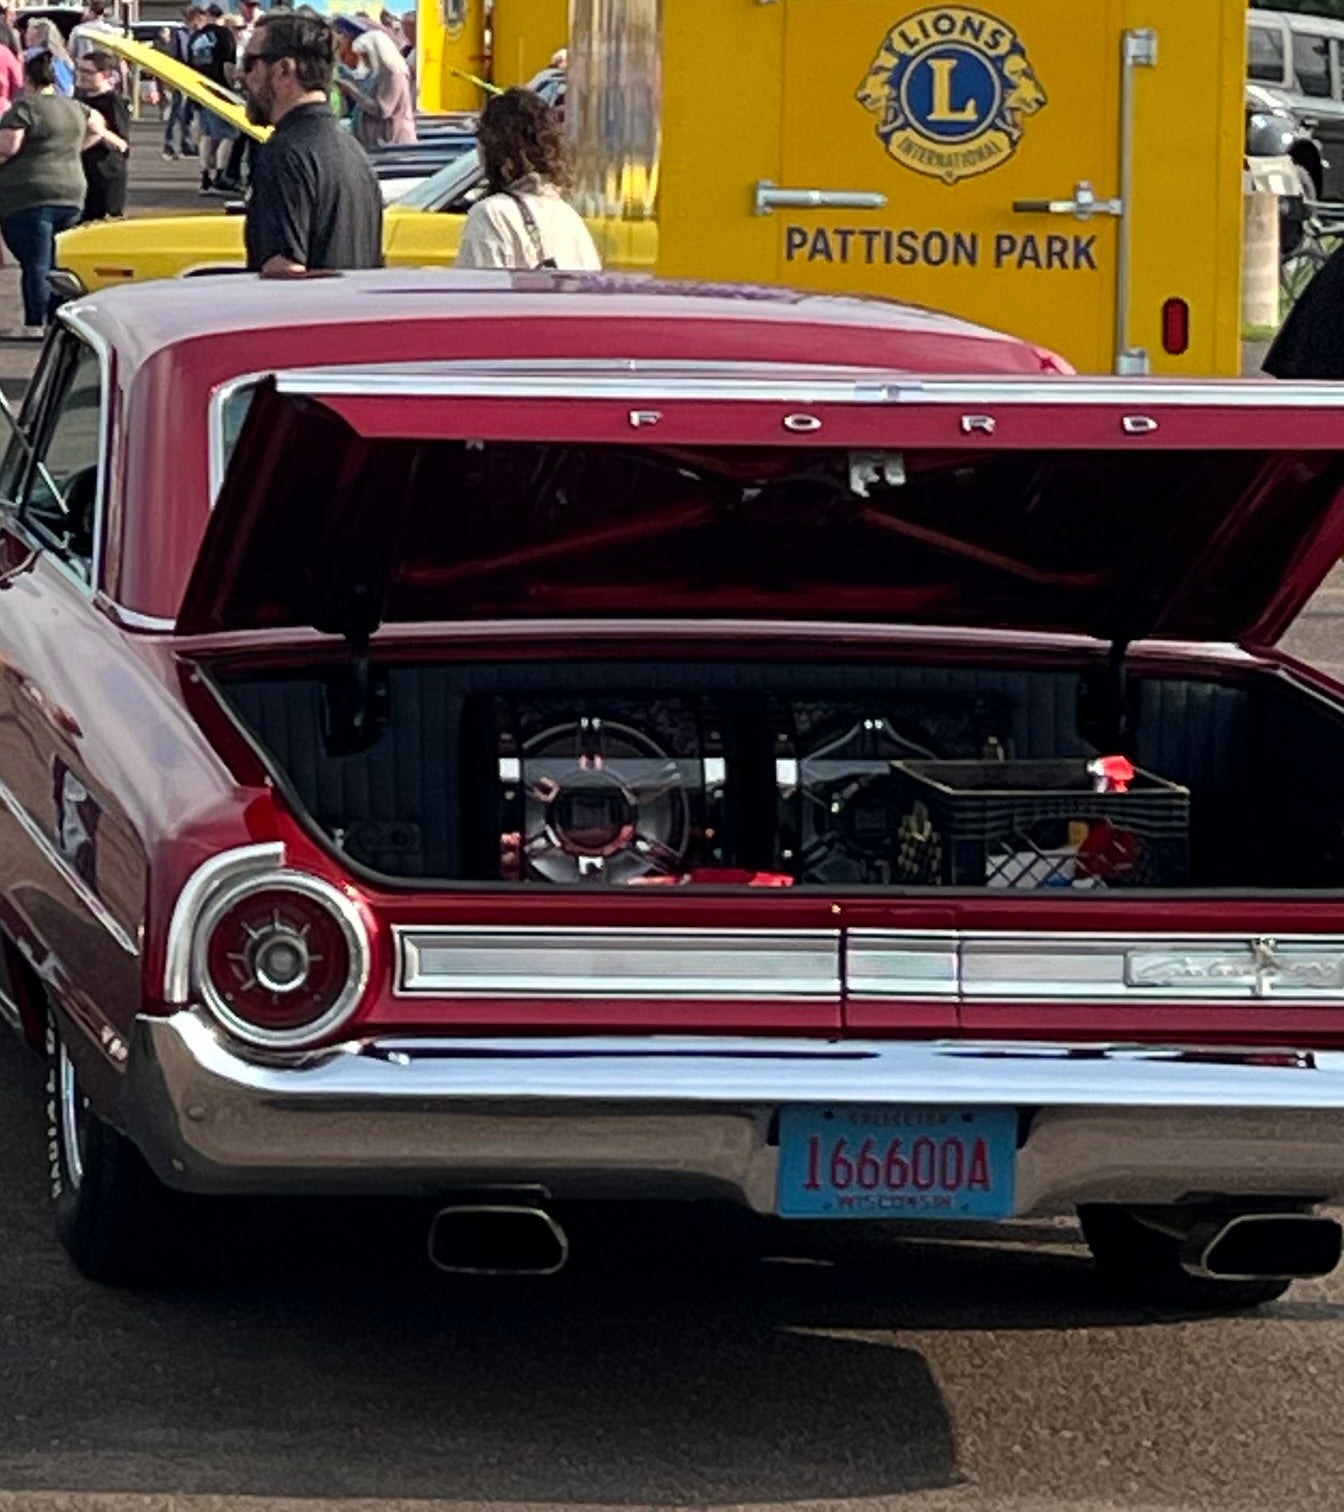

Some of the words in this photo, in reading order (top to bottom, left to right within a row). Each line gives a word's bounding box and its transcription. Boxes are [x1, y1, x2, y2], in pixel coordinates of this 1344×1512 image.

[898, 13, 1006, 50] LIONS
[926, 58, 978, 121] L
[897, 135, 1003, 169] INTERNATIONAL
[785, 226, 978, 266] PATTISON
[994, 233, 1098, 270] PARK
[803, 1135, 992, 1192] 166600A
